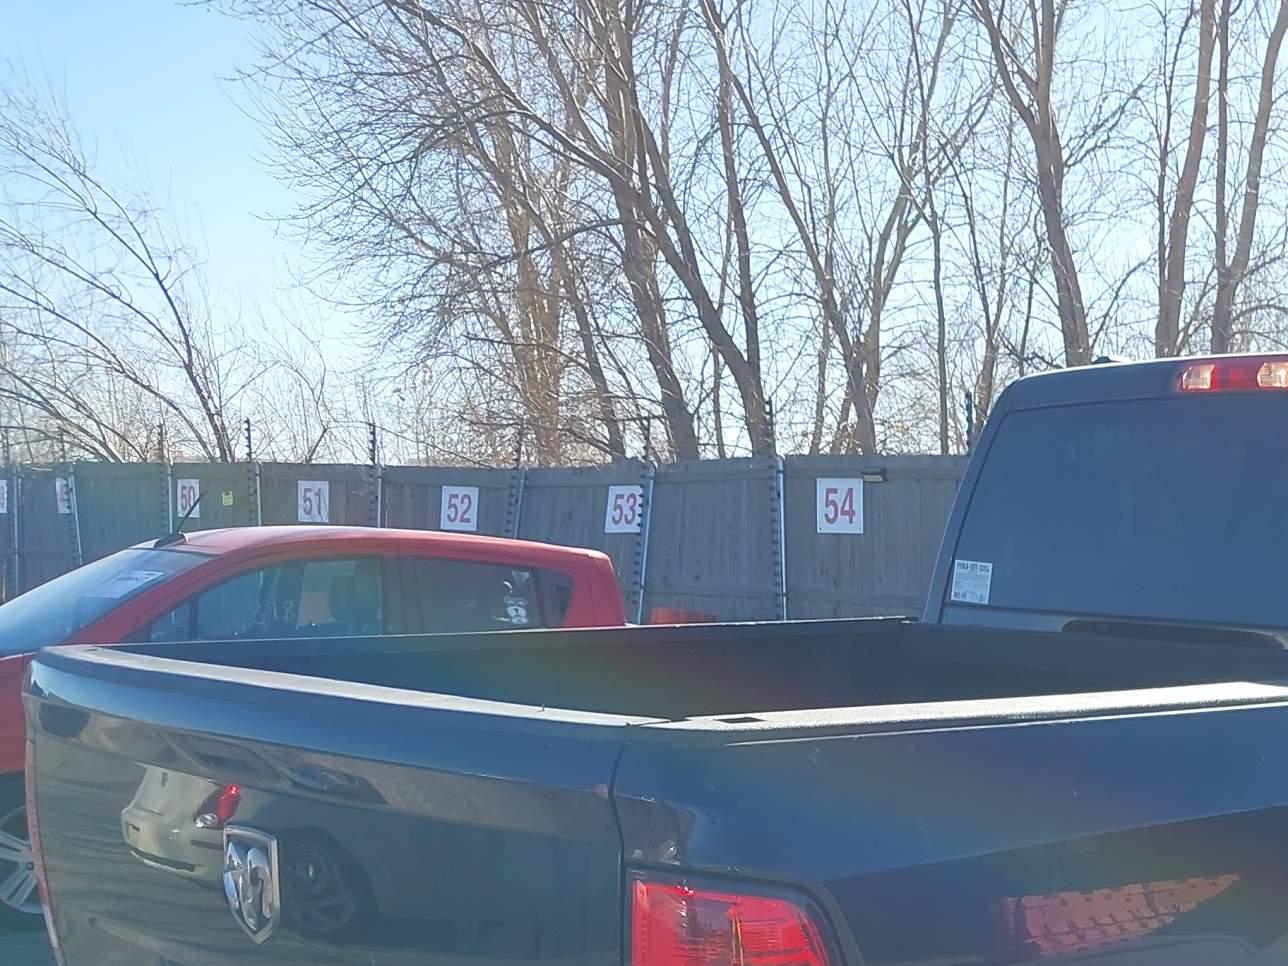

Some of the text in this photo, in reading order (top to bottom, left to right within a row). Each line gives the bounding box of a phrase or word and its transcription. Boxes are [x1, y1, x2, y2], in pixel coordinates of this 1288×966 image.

[180, 485, 196, 512] 50
[303, 487, 322, 515] 51
[446, 493, 472, 523] 52
[611, 493, 638, 525] 53
[824, 487, 856, 525] 54
